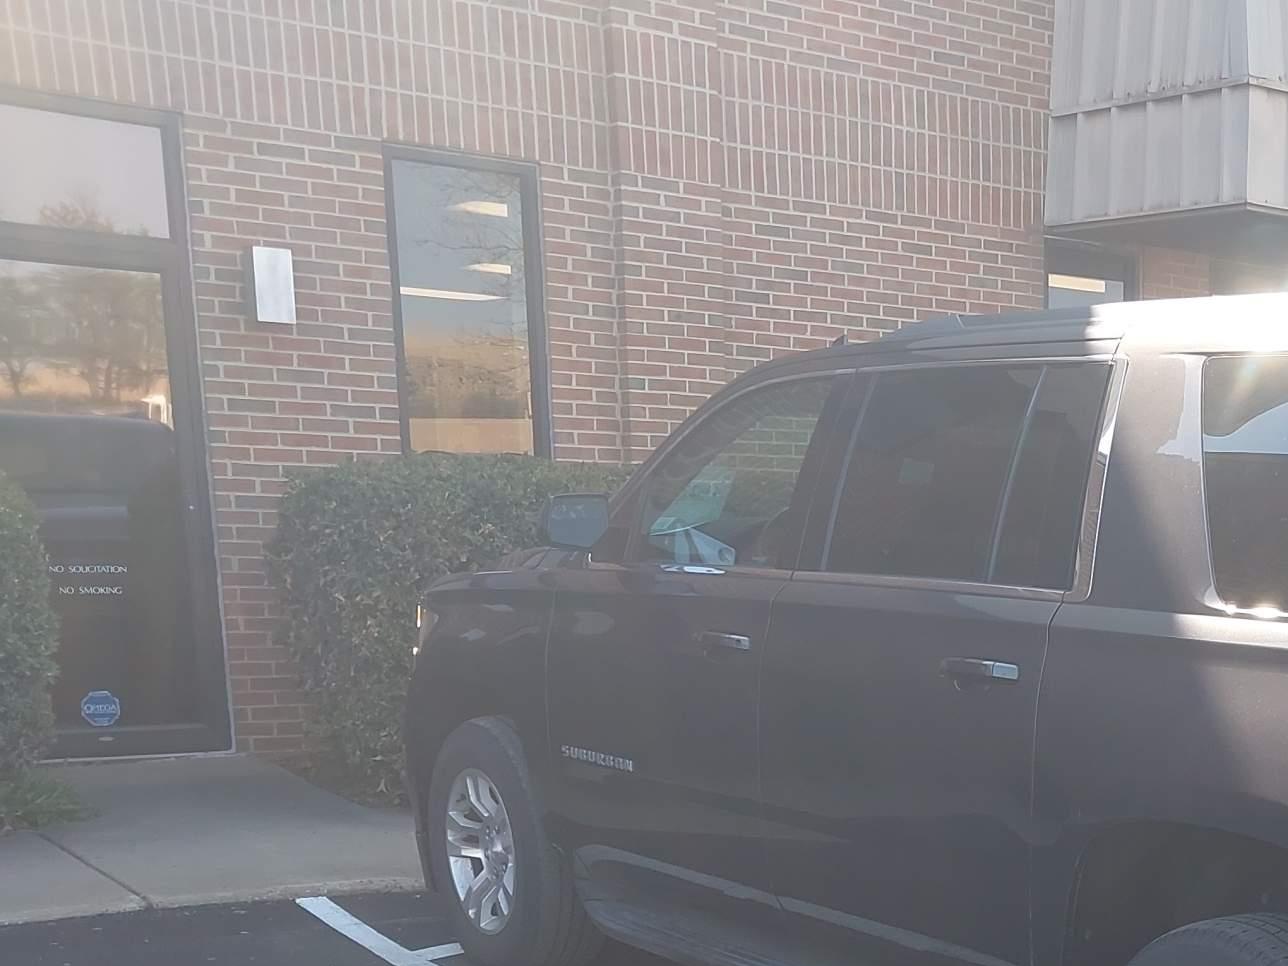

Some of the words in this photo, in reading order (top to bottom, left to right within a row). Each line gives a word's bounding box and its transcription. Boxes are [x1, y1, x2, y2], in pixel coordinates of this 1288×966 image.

[48, 565, 64, 573] NO
[68, 565, 128, 573] SOLICITATION
[59, 586, 75, 594] NO
[79, 586, 123, 594] SMOKING
[561, 744, 633, 772] SUBURBAN
